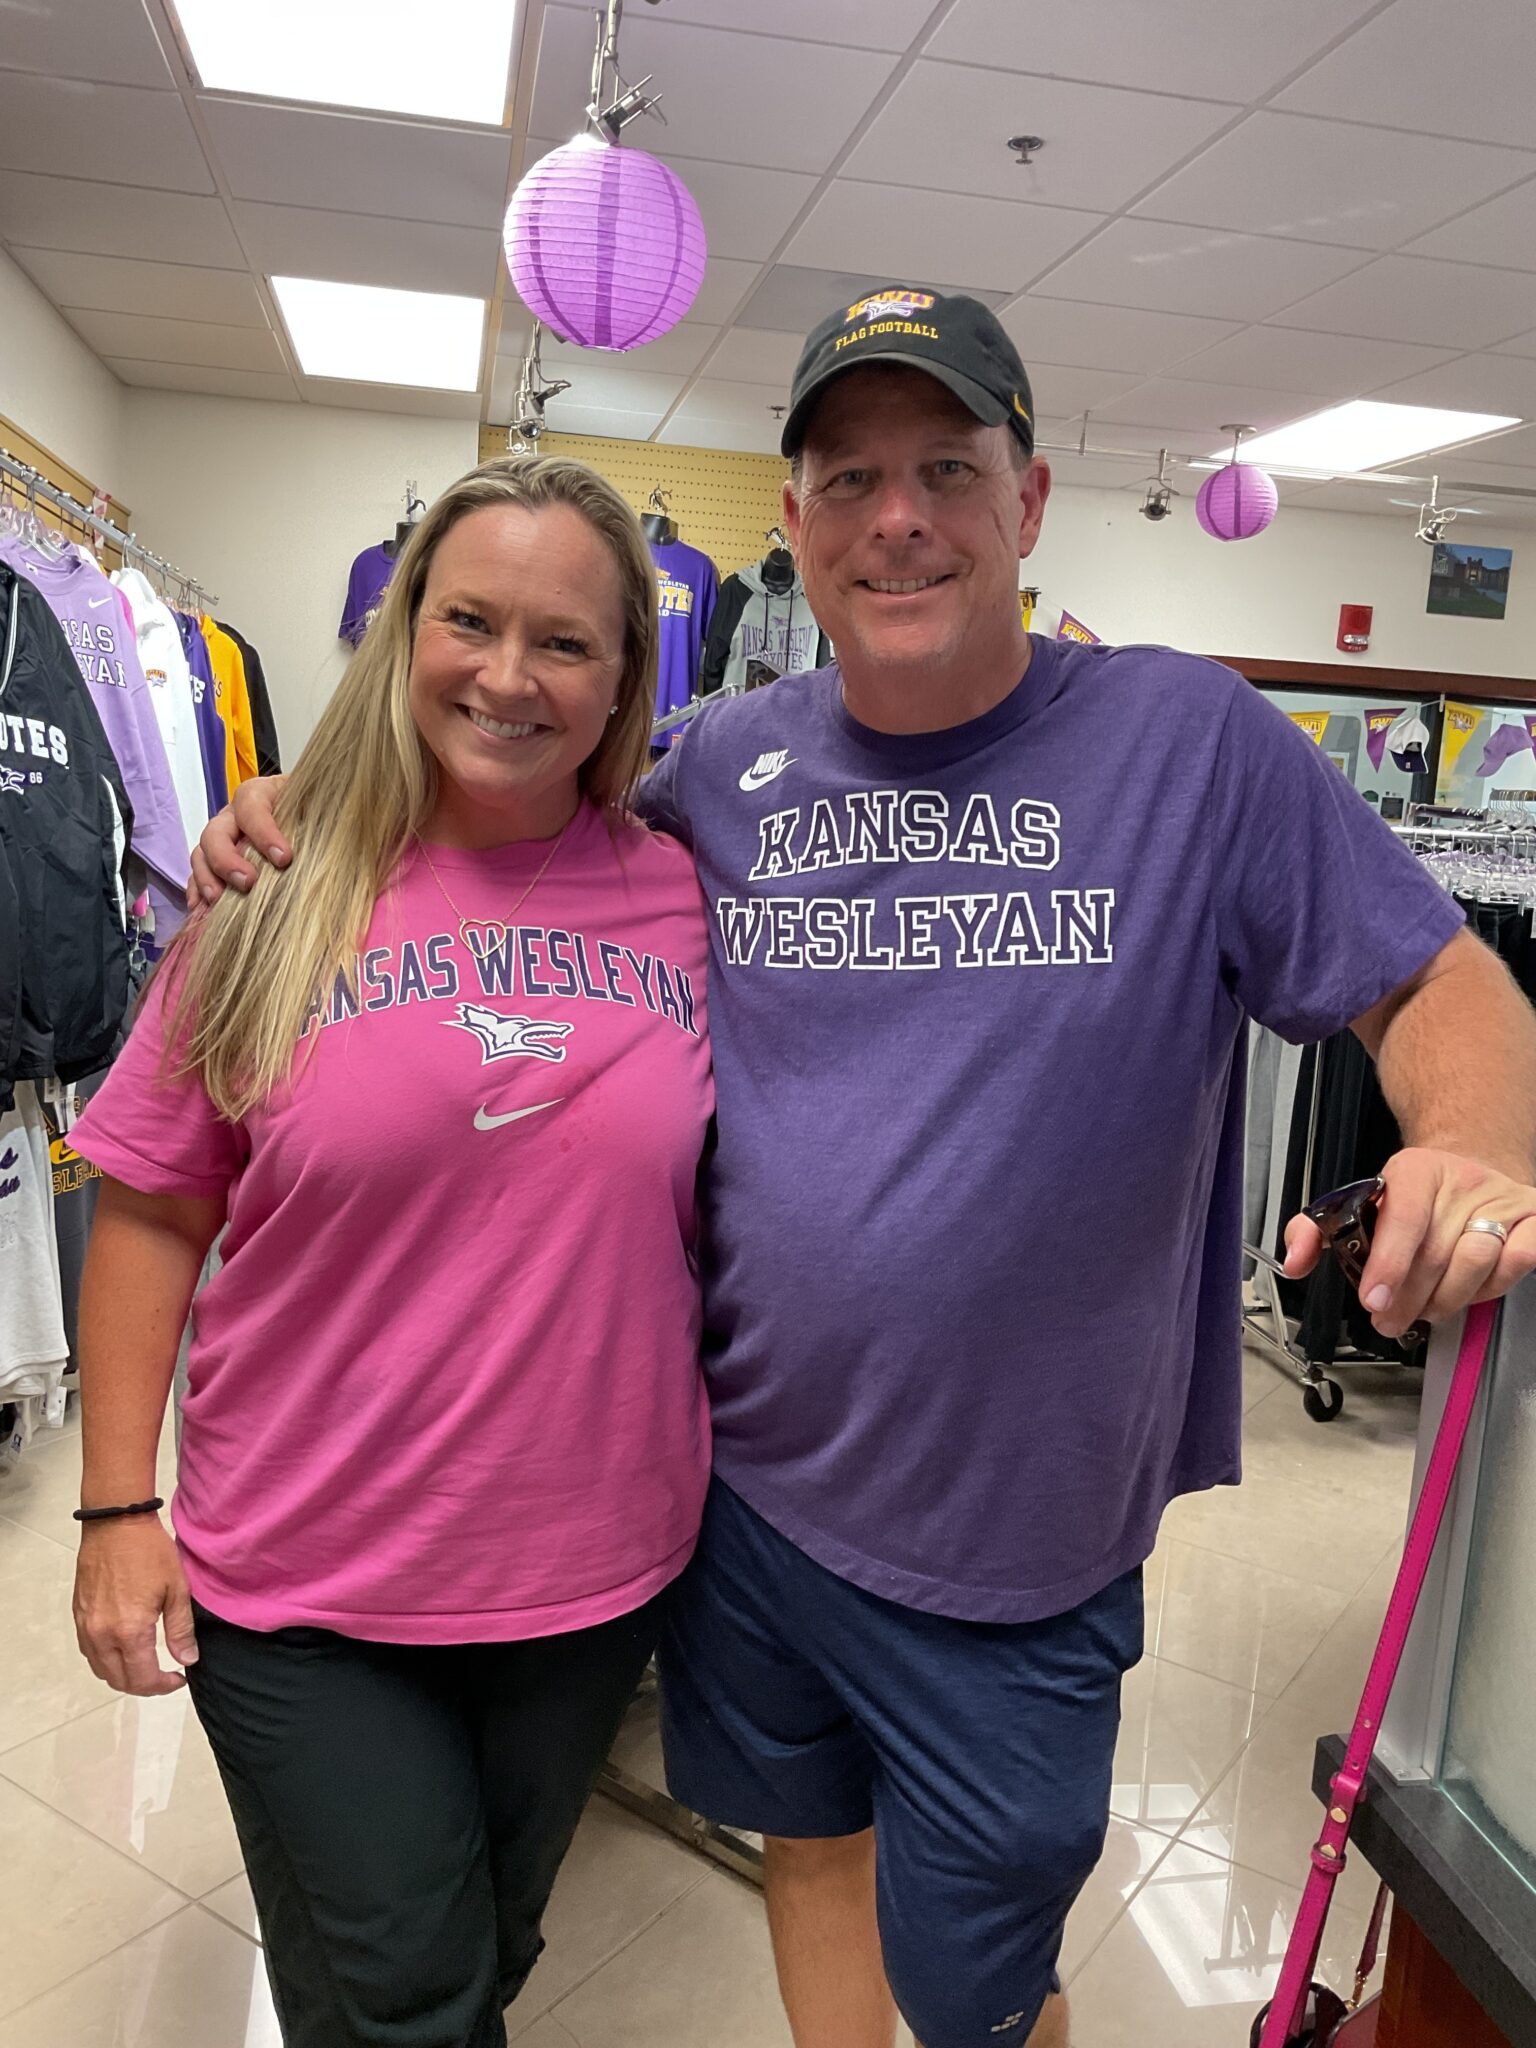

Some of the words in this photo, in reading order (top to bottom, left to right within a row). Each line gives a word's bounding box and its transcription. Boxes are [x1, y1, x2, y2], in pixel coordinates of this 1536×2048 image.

[836, 327, 866, 352] FLAG
[869, 321, 939, 340] FOOTBALL
[741, 624, 774, 658] KANSS
[751, 749, 789, 775] NIKE
[747, 789, 1061, 882] KANSAS
[716, 888, 1115, 971] WESLEYAN
[466, 926, 700, 1039] WESLEYAN
